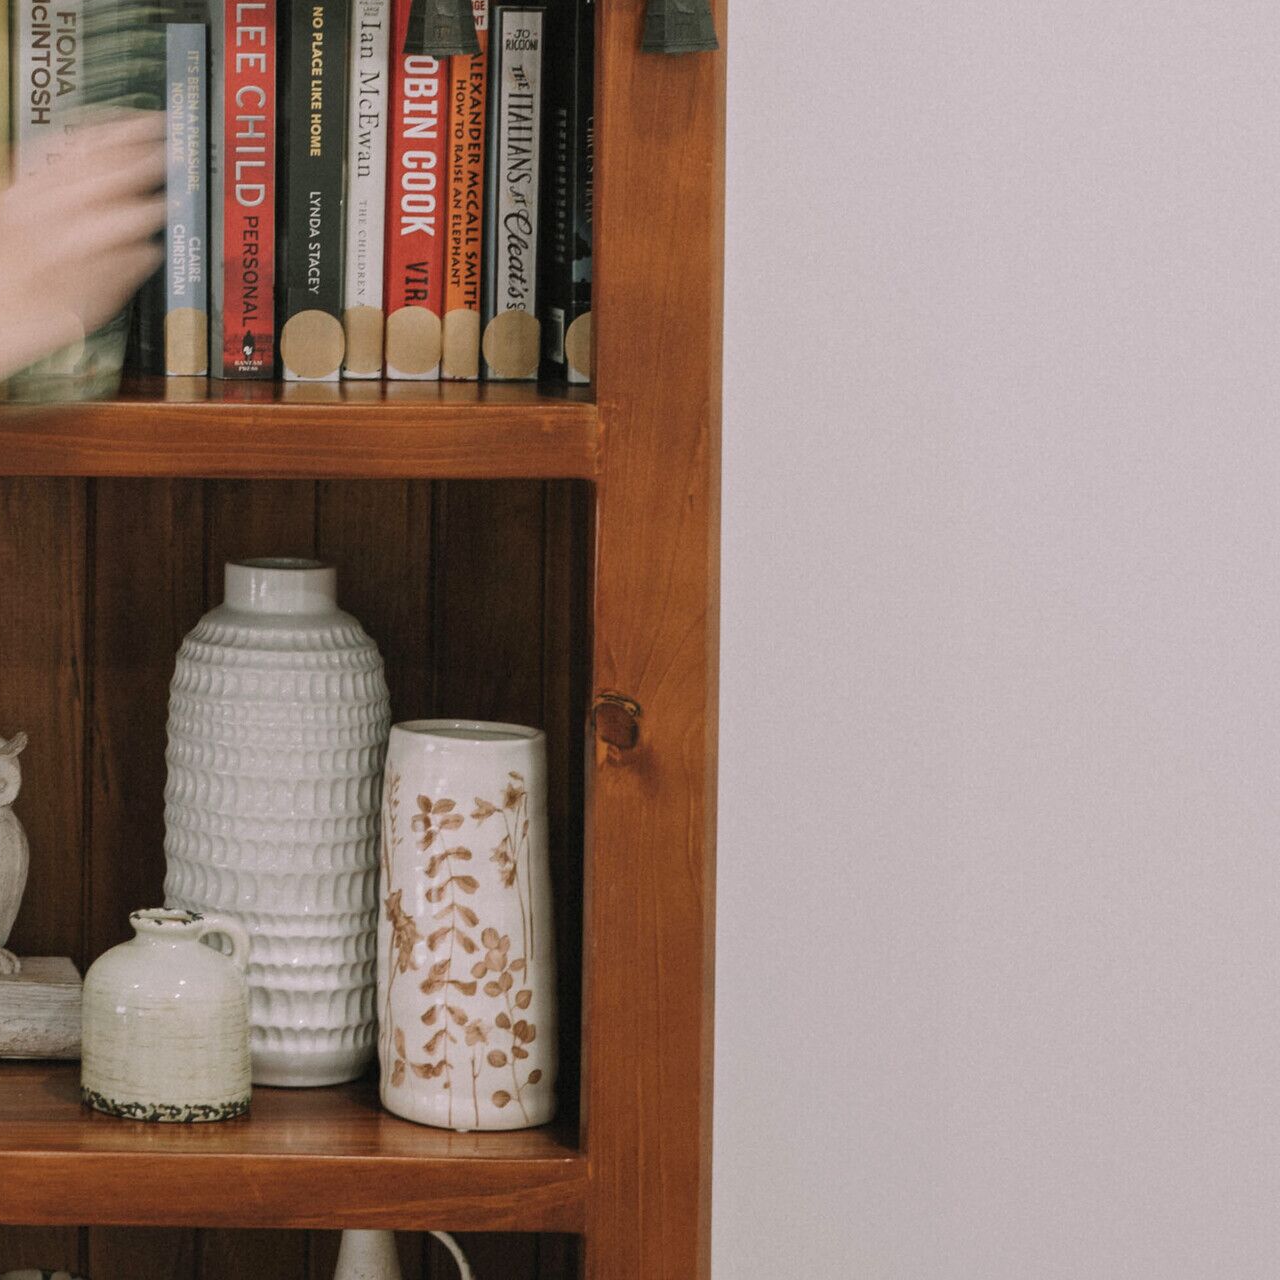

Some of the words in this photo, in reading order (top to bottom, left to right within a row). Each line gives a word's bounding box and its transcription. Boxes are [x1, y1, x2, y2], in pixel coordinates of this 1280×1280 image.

[235, 3, 267, 74] LEE
[312, 6, 324, 28] NO
[360, 20, 381, 59] Ian
[56, 11, 77, 98] FIONA
[311, 32, 323, 76] PLACE
[505, 39, 539, 51] RICCIONI
[310, 80, 322, 110] LIKE
[402, 54, 439, 139] OBIN
[455, 79, 467, 118] HOW
[235, 85, 267, 207] CHILD
[310, 114, 322, 157] HOME
[357, 70, 380, 178] McEwan
[454, 122, 465, 140] TO
[506, 93, 534, 184] ITALIANS
[453, 144, 464, 184] RAISE
[308, 191, 322, 238] LYNDA
[358, 200, 368, 226] THE
[400, 150, 438, 237] COOK
[453, 188, 463, 210] AN
[172, 224, 186, 296] CHRISTIAN
[188, 236, 201, 283] CLAIRE
[241, 215, 260, 328] PERSONAL
[307, 242, 321, 295] STACEY
[356, 230, 367, 296] CHILDREN
[450, 214, 462, 287] ELEPHANT
